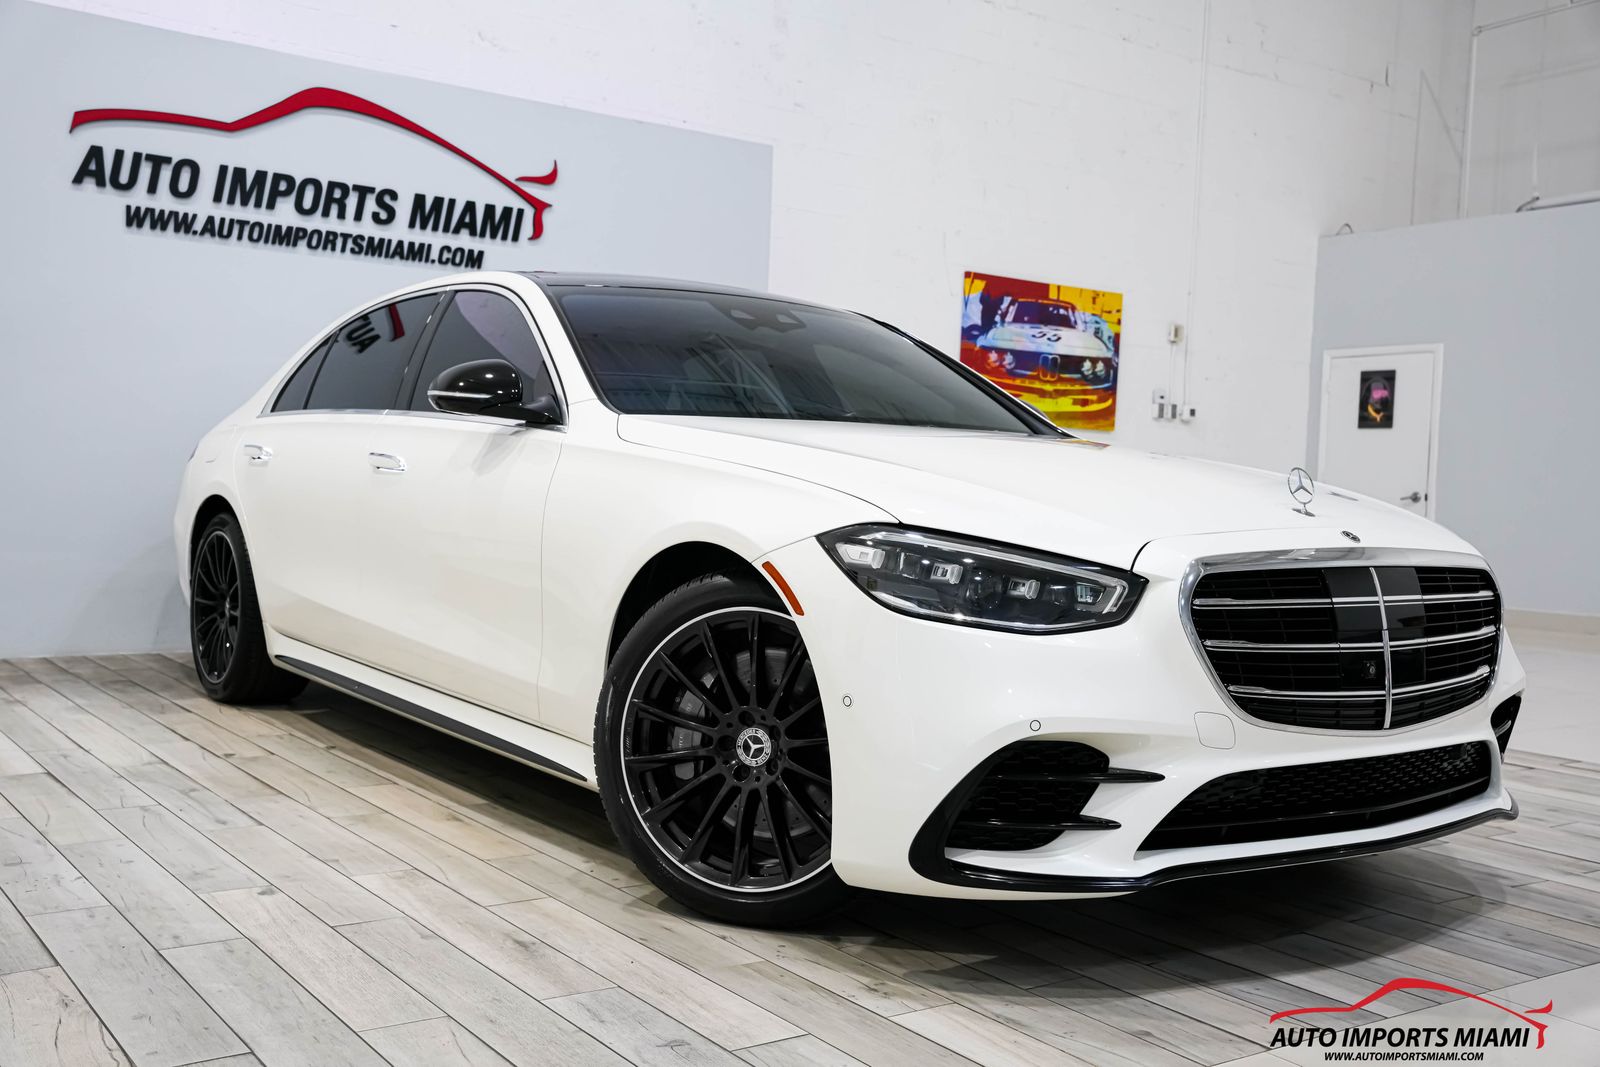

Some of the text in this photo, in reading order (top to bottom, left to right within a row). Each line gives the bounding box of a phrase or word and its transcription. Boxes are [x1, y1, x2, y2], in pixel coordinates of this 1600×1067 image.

[71, 145, 525, 243] AUTO IMPORTS MIAMI
[125, 204, 485, 270] WWW.AUTOIMPORTSMIAMI.COM
